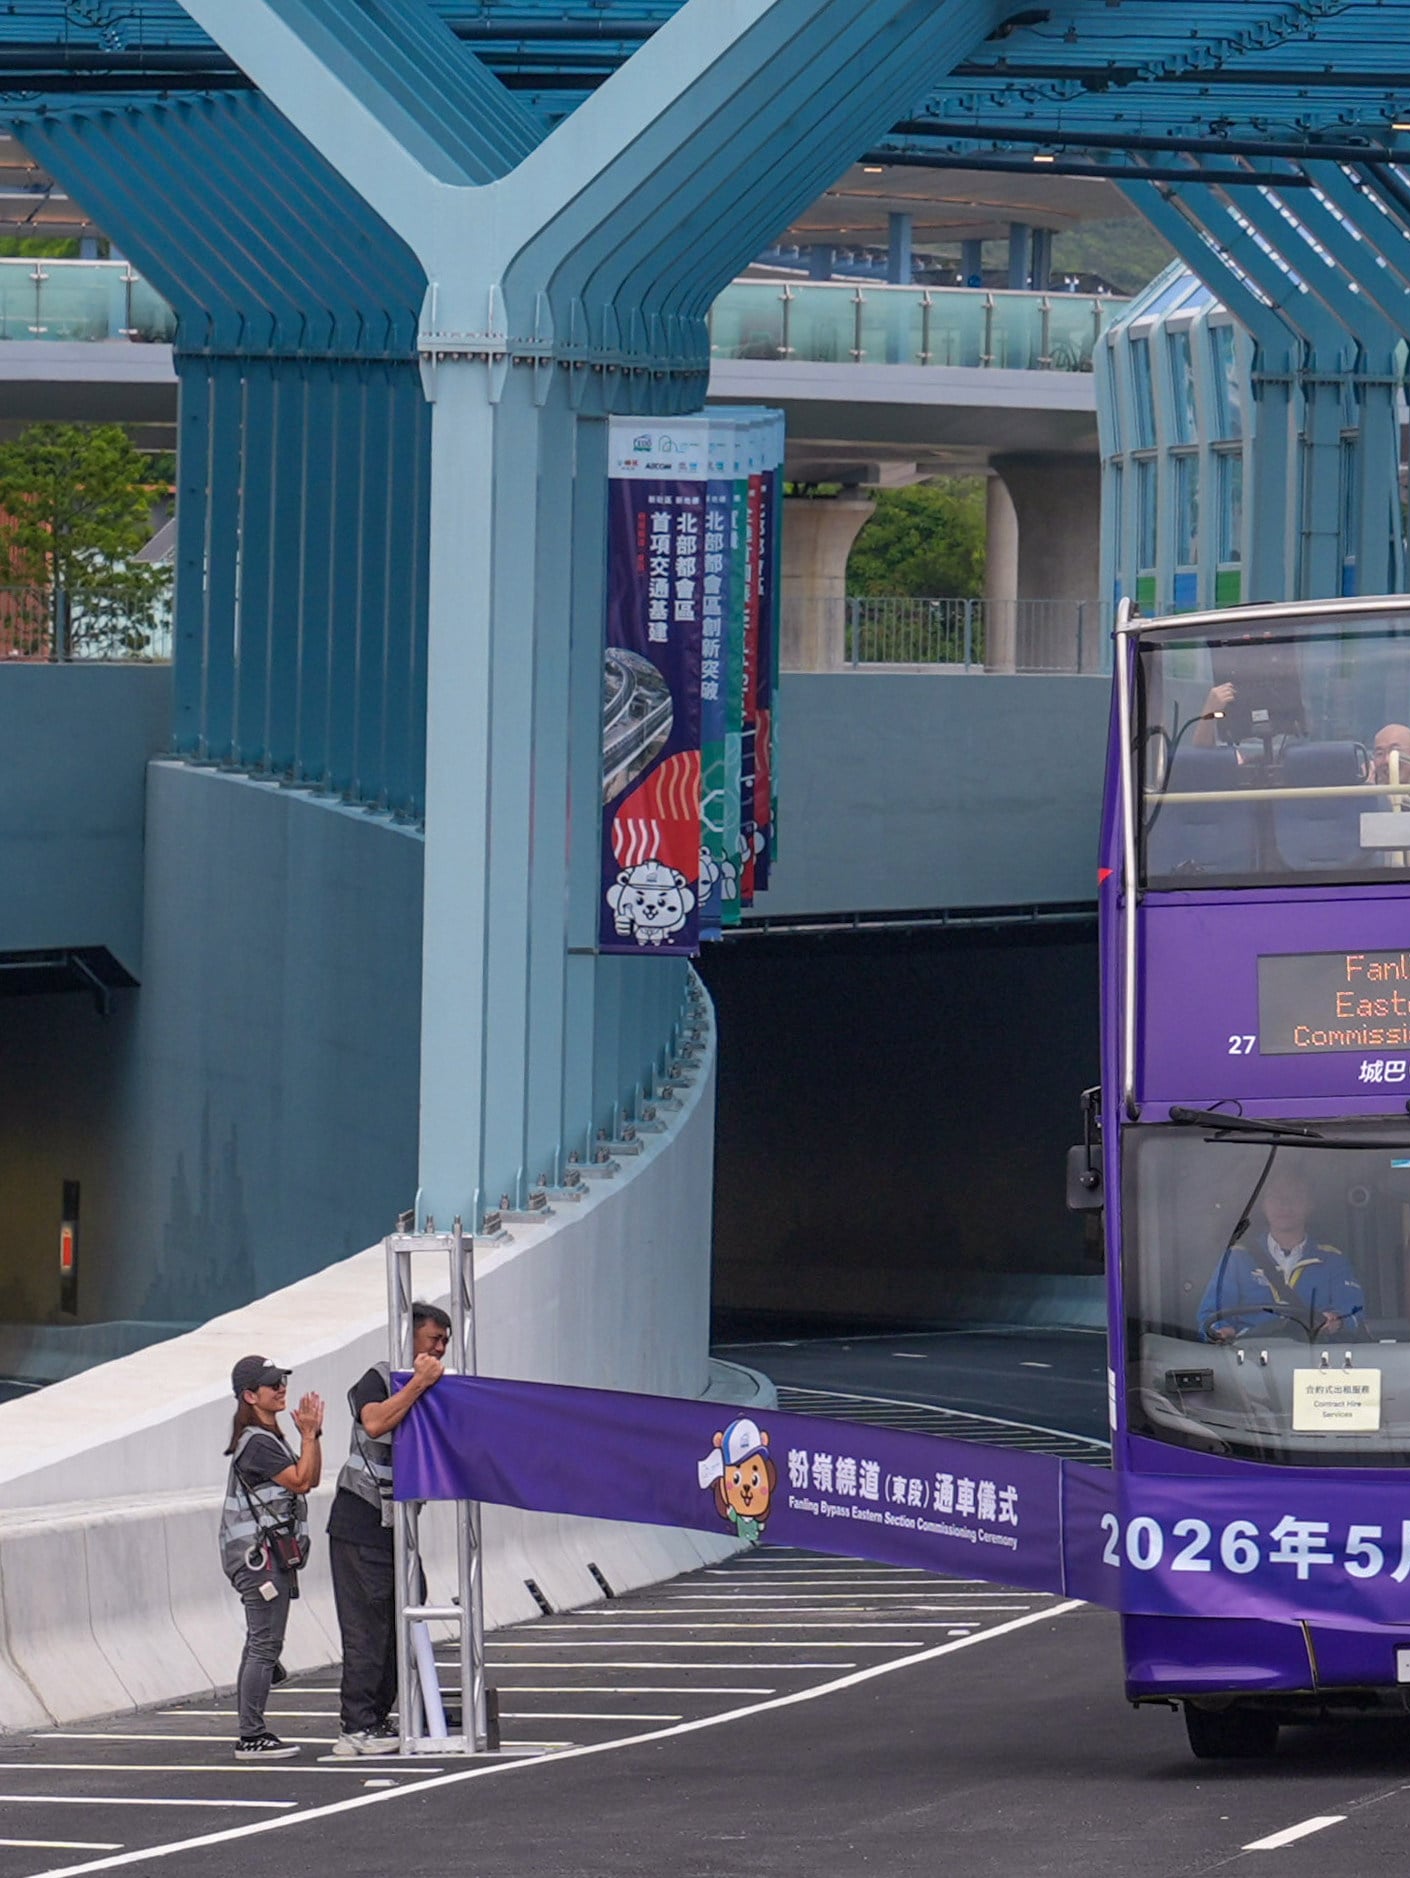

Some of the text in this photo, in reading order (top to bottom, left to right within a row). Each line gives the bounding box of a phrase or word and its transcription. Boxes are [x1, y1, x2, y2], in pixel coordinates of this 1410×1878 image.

[648, 511, 671, 643] 首項交通基建
[674, 512, 698, 621] 北部都會區
[700, 511, 724, 701] 北部都會區創新突破
[1228, 1035, 1256, 1055] 27
[1358, 1059, 1406, 1083] 城巴
[1313, 1400, 1362, 1408] Contract Hire
[788, 1495, 1018, 1551] Fanling Bypass Eastern Section Commissioning Ceremony
